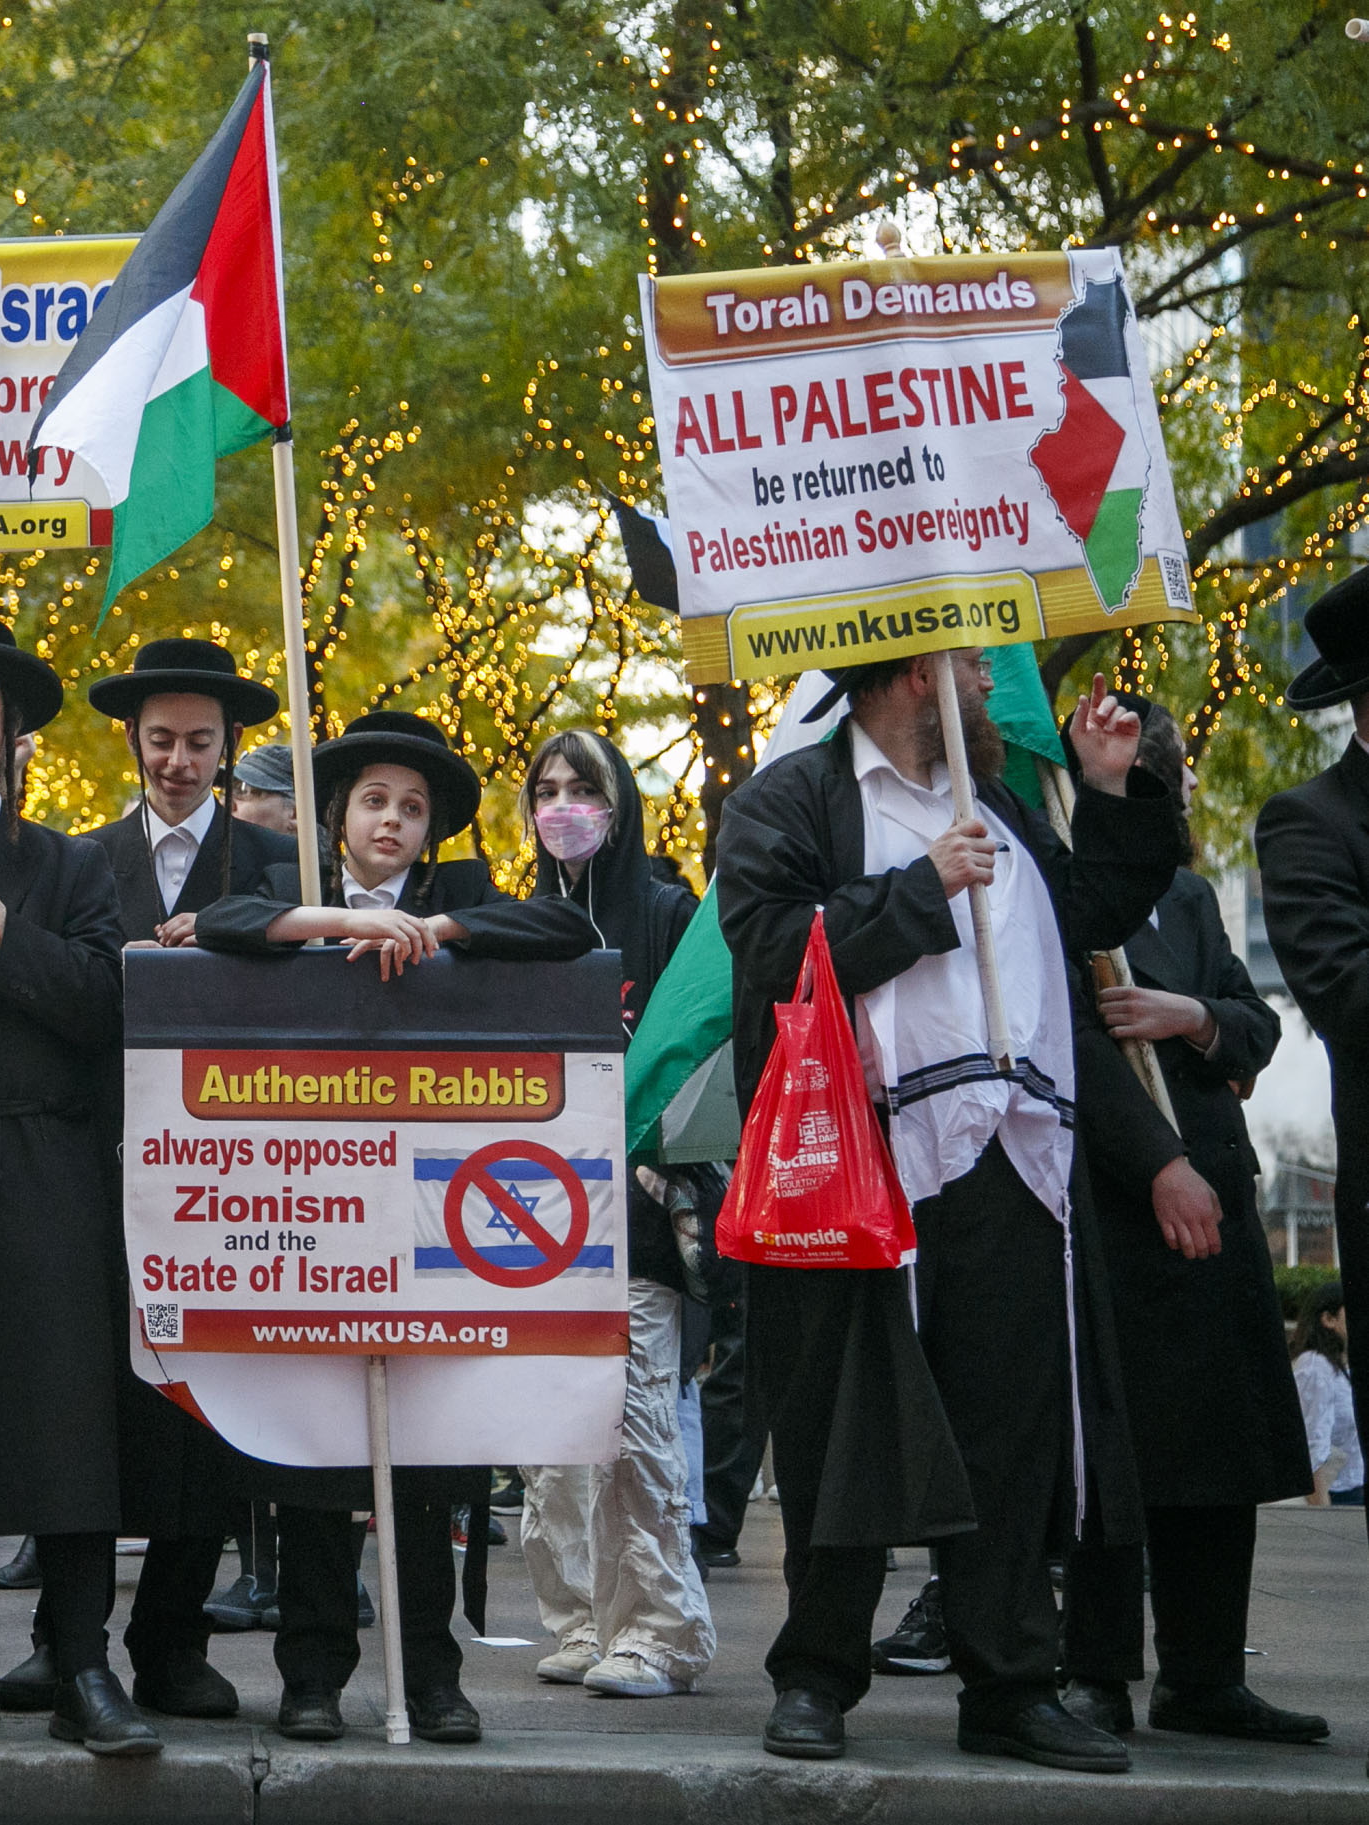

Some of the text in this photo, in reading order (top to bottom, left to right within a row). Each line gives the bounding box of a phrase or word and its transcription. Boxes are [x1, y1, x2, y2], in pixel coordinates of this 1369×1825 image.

[706, 271, 1036, 335] Torah Demands
[674, 361, 1035, 458] ALL PALESTINE
[752, 443, 946, 507] be returned to
[686, 499, 1030, 575] Palestinian Sovereignty
[747, 597, 1021, 659] www.nkusa.org
[198, 1064, 549, 1106] Authentic Rabbis
[142, 1129, 397, 1175] always opposed
[173, 1185, 365, 1224] Zionism
[223, 1230, 317, 1252] and the
[142, 1254, 399, 1294] State of Israel
[252, 1320, 509, 1349] www.NKUSA.org
